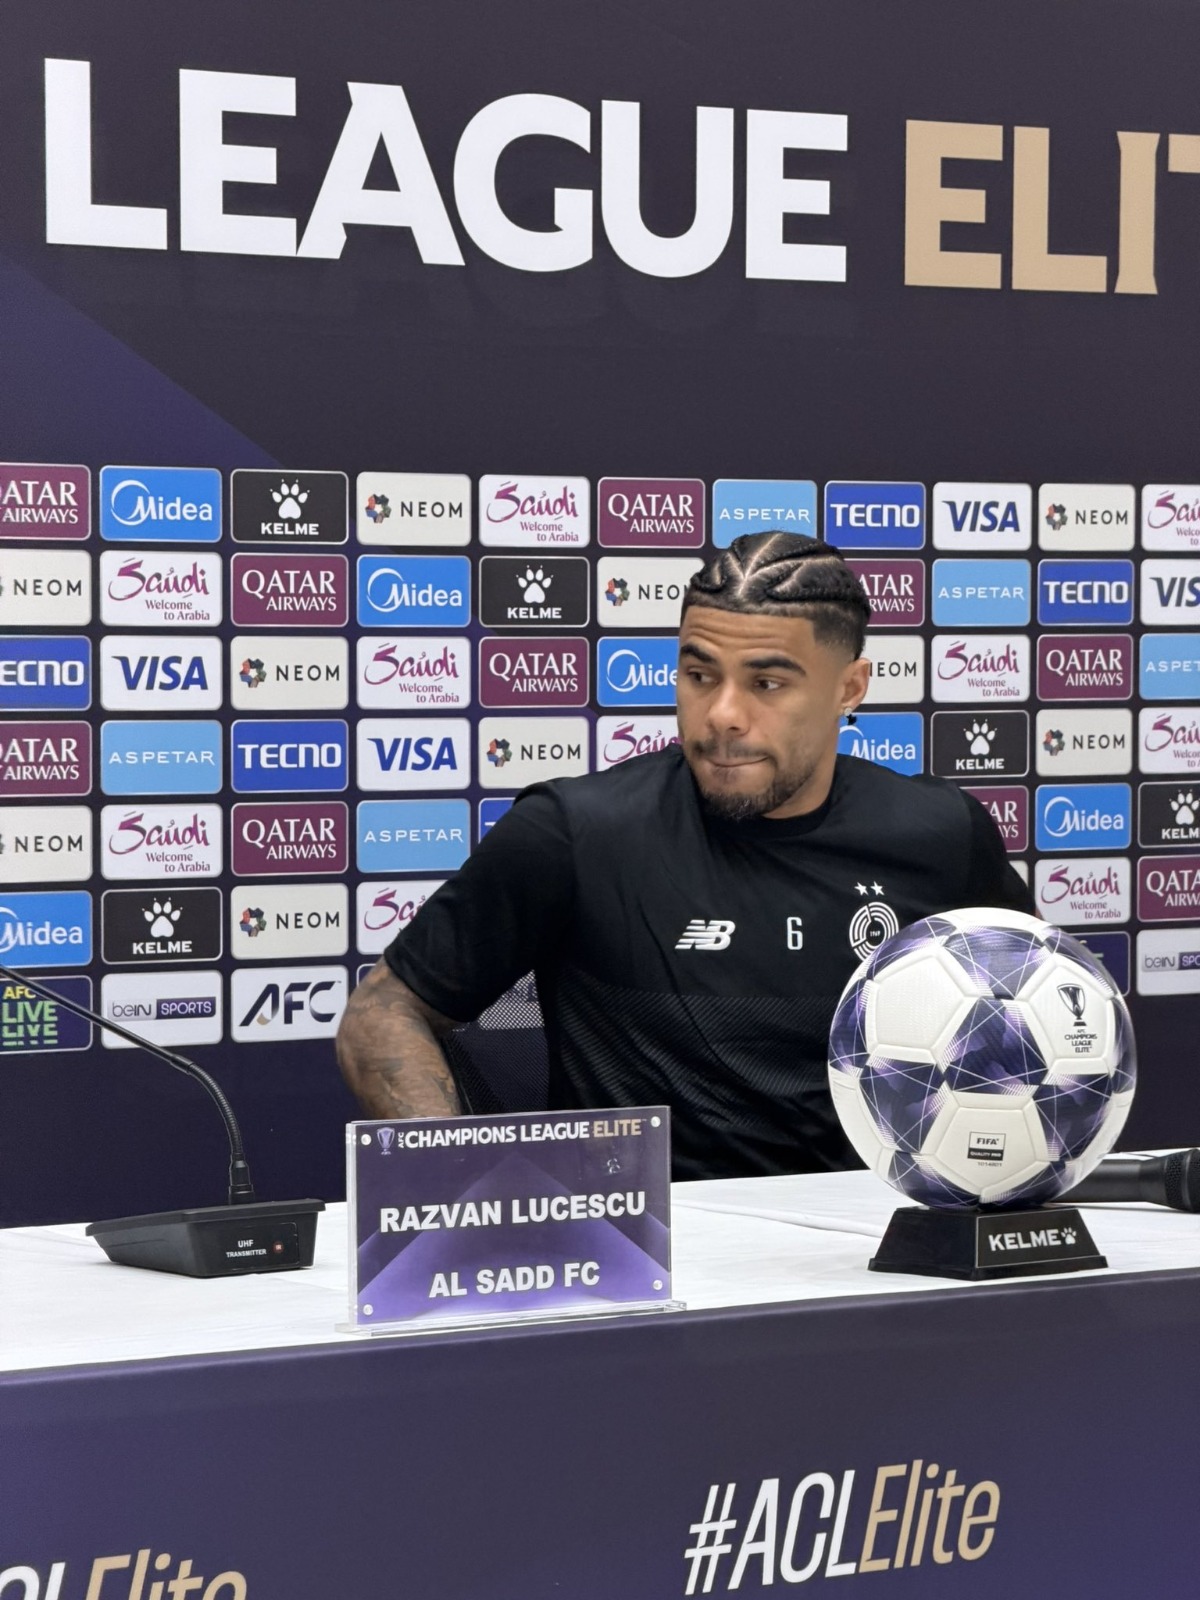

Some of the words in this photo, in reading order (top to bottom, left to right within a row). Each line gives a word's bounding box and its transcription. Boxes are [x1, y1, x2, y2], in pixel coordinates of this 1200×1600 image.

[44, 57, 848, 283] LEAGUE
[904, 119, 1200, 295] ELI
[0, 480, 78, 506] ATAR
[128, 493, 212, 522] Midea
[401, 501, 463, 518] NEOM
[486, 481, 579, 523] Saudi
[608, 493, 694, 521] QATAR
[1148, 490, 1200, 529] Sau
[2, 508, 79, 524] AIRWAYS
[719, 508, 811, 524] ASPETAR
[830, 504, 921, 528] TECNO
[942, 501, 1020, 532] VISA
[1075, 509, 1128, 525] NEOM
[261, 523, 319, 536] KELME
[520, 521, 563, 531] Welcome
[630, 519, 694, 533] AIRWAYS
[1176, 527, 1200, 536] Welco
[536, 532, 546, 542] to
[548, 532, 579, 542] Arabia
[1190, 537, 1199, 545] to
[13, 579, 82, 596] NEOM
[108, 557, 209, 601] Saudi
[242, 569, 336, 599] QATAR
[383, 583, 462, 608] Midea
[638, 584, 688, 600] NEO
[938, 585, 1025, 601] ASPETAR
[1044, 580, 1129, 604] TECNO
[1149, 577, 1200, 607] VIS
[145, 599, 192, 610] Welcome
[266, 597, 337, 611] AIRWAYS
[869, 599, 915, 612] RWAYS
[164, 611, 175, 621] to
[177, 610, 210, 621] Arabia
[508, 607, 562, 619] KELME
[364, 643, 459, 685] Saudi
[489, 652, 577, 680] QATAR
[937, 640, 1020, 680] Saudi
[1046, 649, 1122, 675] QATAR
[1145, 660, 1200, 672] ASPET
[0, 660, 84, 686] ECNO
[111, 655, 208, 691] VISA
[276, 665, 340, 682] NEOM
[619, 661, 677, 688] Mide
[1066, 672, 1123, 686] AIRWAYS
[399, 683, 443, 693] Welcome
[512, 678, 578, 692] AIRWAYS
[967, 678, 1006, 688] Welcome
[416, 693, 426, 703] to
[428, 693, 460, 703] Arabia
[983, 688, 992, 697] to
[993, 687, 1020, 697] Arabia
[1145, 713, 1200, 752] Sau
[0, 738, 79, 763] ATAR
[603, 722, 684, 763] Sau
[849, 737, 916, 761] Midea
[1073, 734, 1126, 750] NEOM
[108, 750, 215, 766] ASPETAR
[238, 743, 341, 768] TECNO
[367, 737, 457, 771] VISA
[521, 744, 581, 761] NEOM
[1173, 750, 1200, 759] Welco
[955, 758, 1005, 770] KELME
[1187, 759, 1197, 768] to
[3, 765, 80, 780] AIRWAYS
[1060, 806, 1124, 834] Midea
[109, 811, 210, 855] Saudi
[242, 818, 336, 848] QATAR
[363, 828, 464, 843] ASPETAR
[1161, 828, 1200, 840] KELM
[14, 835, 83, 853] NEOM
[266, 845, 337, 860] AIRWAYS
[146, 852, 193, 863] Welcome
[164, 863, 175, 873] to
[177, 861, 210, 873] Arabia
[1041, 865, 1121, 904] Saudi
[1146, 869, 1200, 897] QATA
[1069, 900, 1108, 911] Welcome
[1164, 892, 1200, 907] AIRW
[276, 912, 340, 930] NEOM
[1085, 910, 1094, 919] to
[1095, 909, 1121, 919] Arabia
[0, 920, 83, 948] Midea
[787, 917, 803, 950] 6
[132, 940, 192, 954] KELME
[1181, 955, 1200, 967] SPO
[3, 985, 37, 999] AFC
[2, 1001, 58, 1023] LIVE
[160, 1001, 212, 1016] SPORTS
[239, 981, 337, 1026] AFC
[405, 1126, 516, 1149] CHAMPIONS
[520, 1122, 589, 1142] LEAGUE
[593, 1119, 642, 1137] ELITE
[977, 1137, 998, 1145] FIFA
[380, 1200, 501, 1233] RAZVAN
[511, 1191, 645, 1224] LUCESCU
[238, 1240, 254, 1248] UHF
[988, 1229, 1061, 1251] KELME
[226, 1249, 267, 1258] TRANSMITTER
[429, 1272, 468, 1298] AL
[476, 1267, 555, 1294] SADD
[564, 1261, 600, 1287] FC
[684, 1459, 1000, 1595] #ACLElite
